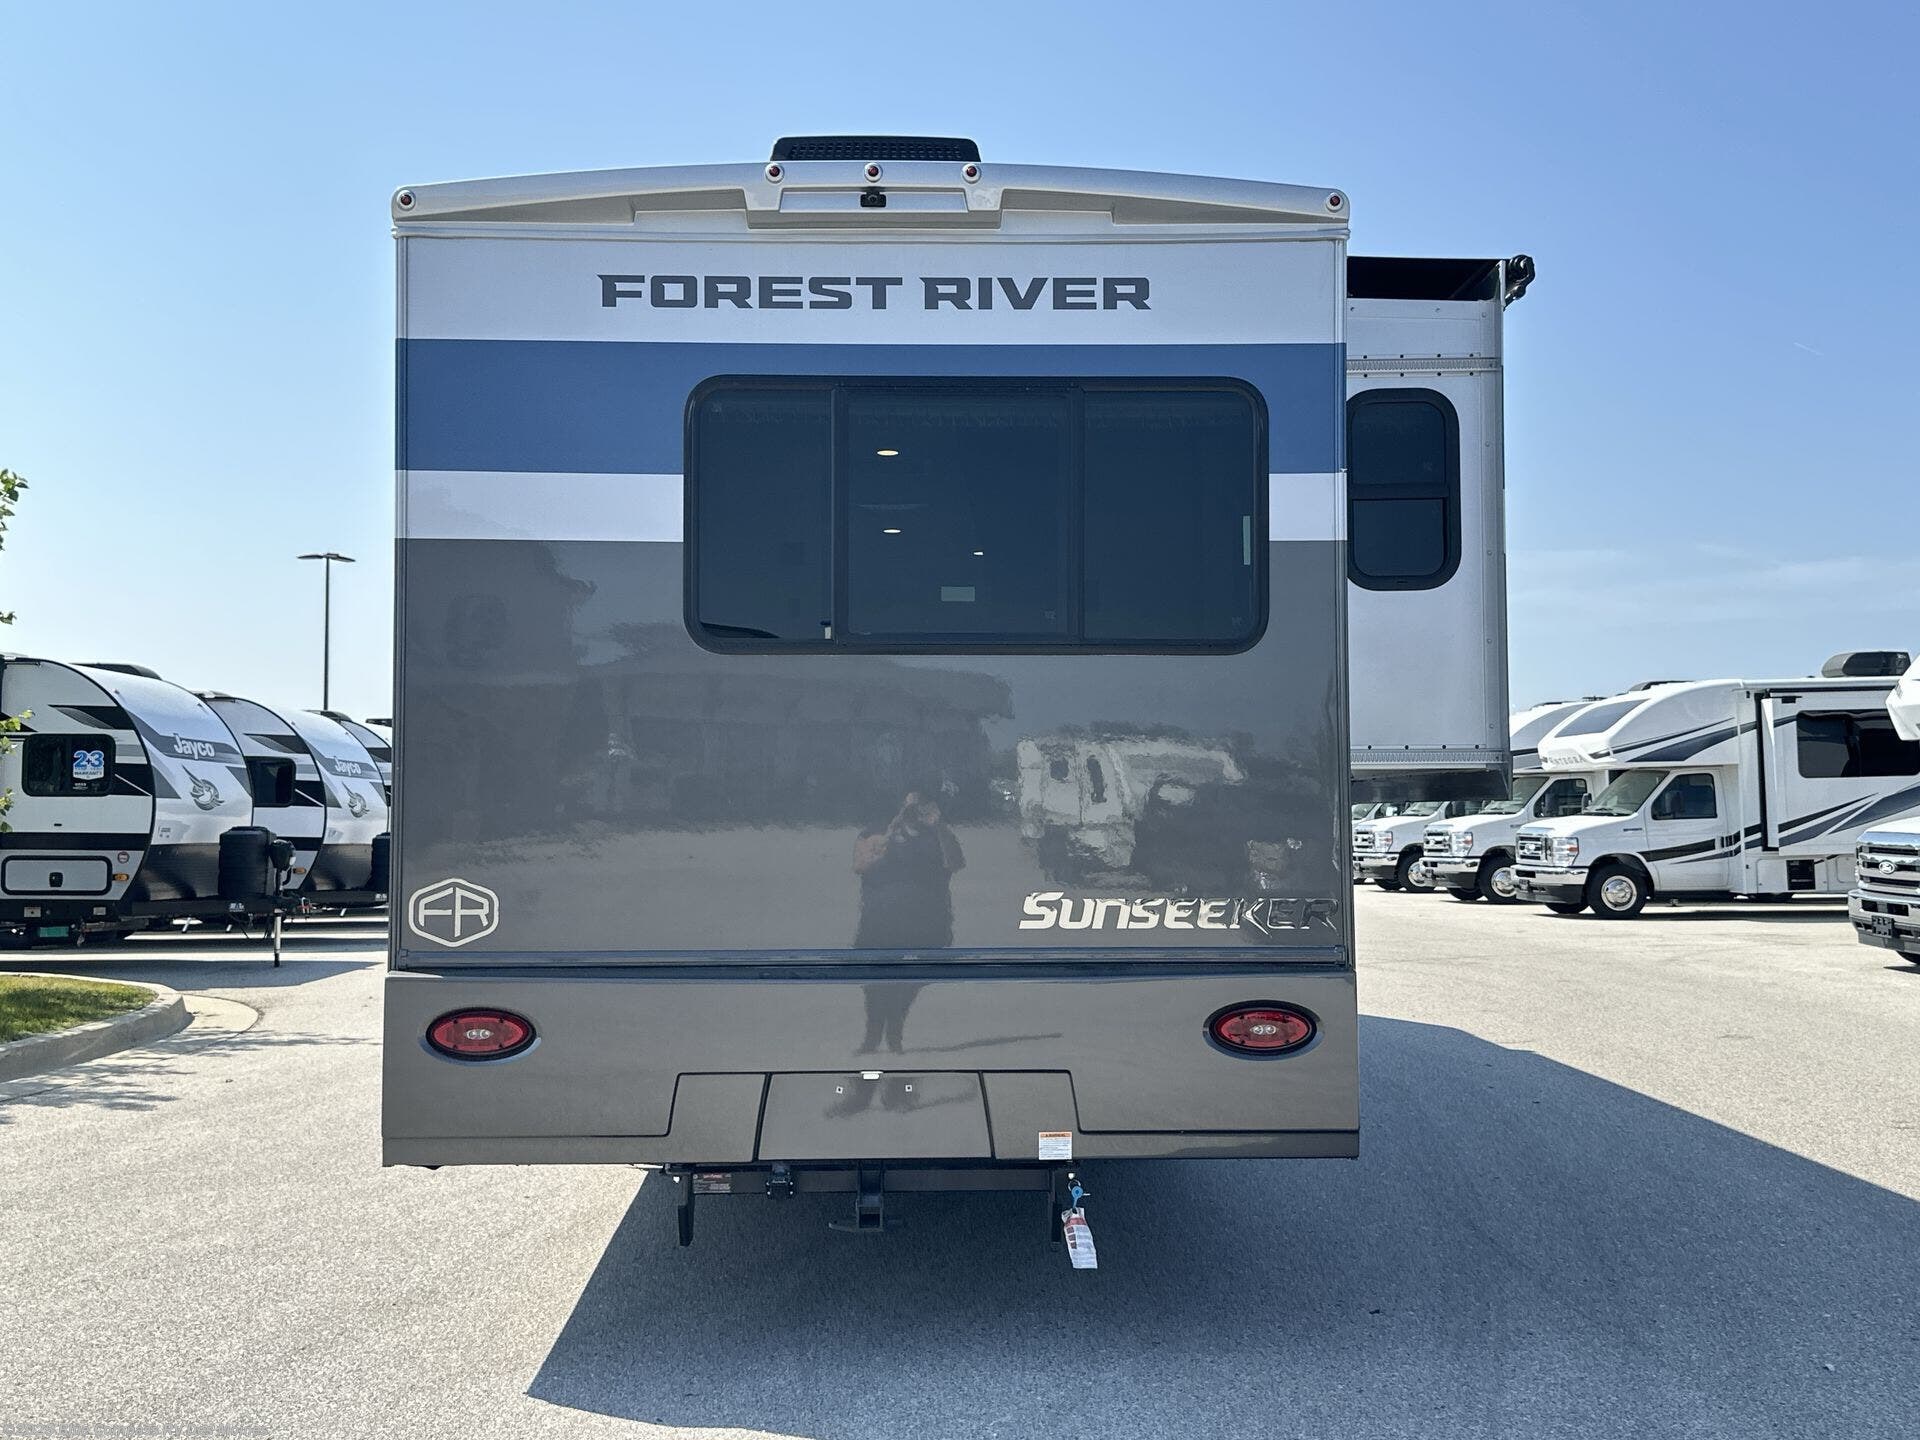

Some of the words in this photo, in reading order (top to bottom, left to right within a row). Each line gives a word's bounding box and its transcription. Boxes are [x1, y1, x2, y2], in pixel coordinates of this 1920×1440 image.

[597, 275, 902, 310] FOREST
[919, 276, 1152, 310] RIVER
[173, 733, 215, 760] Jayco
[334, 756, 362, 776] Jayco
